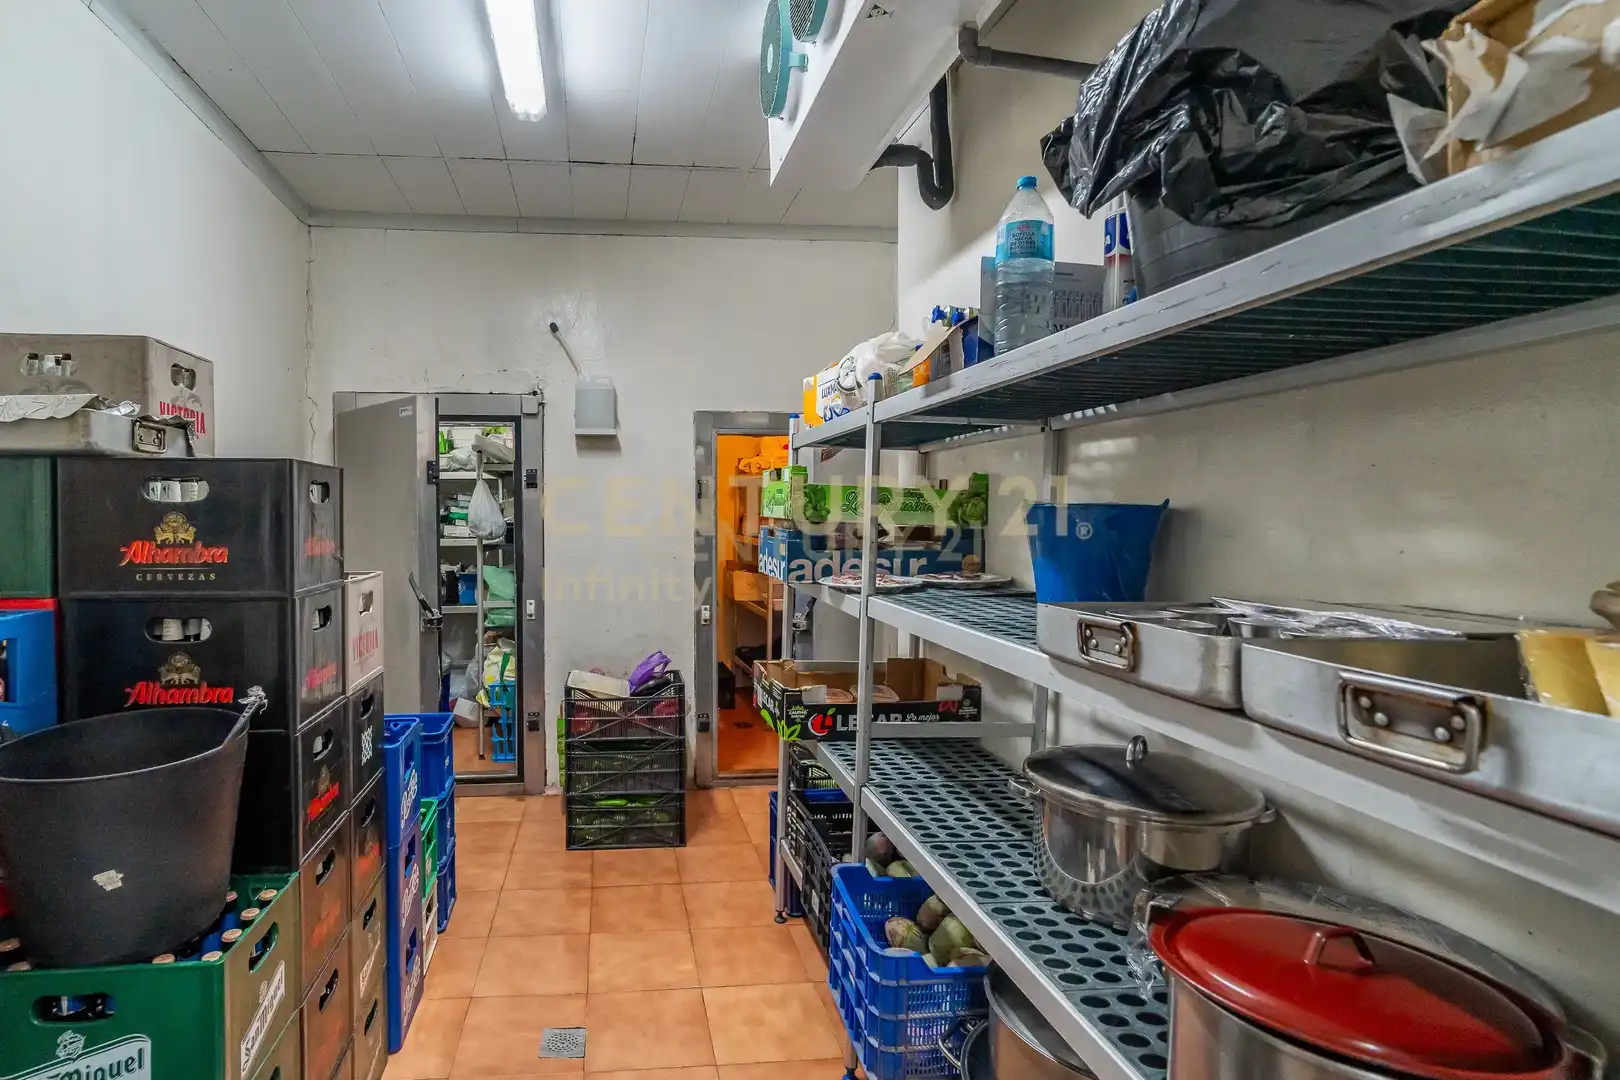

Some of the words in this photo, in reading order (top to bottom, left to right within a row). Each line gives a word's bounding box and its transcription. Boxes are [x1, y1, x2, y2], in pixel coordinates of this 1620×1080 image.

[119, 541, 229, 567] Alhambra
[135, 573, 217, 582] CERVEZAS
[124, 680, 234, 707] Alhambra
